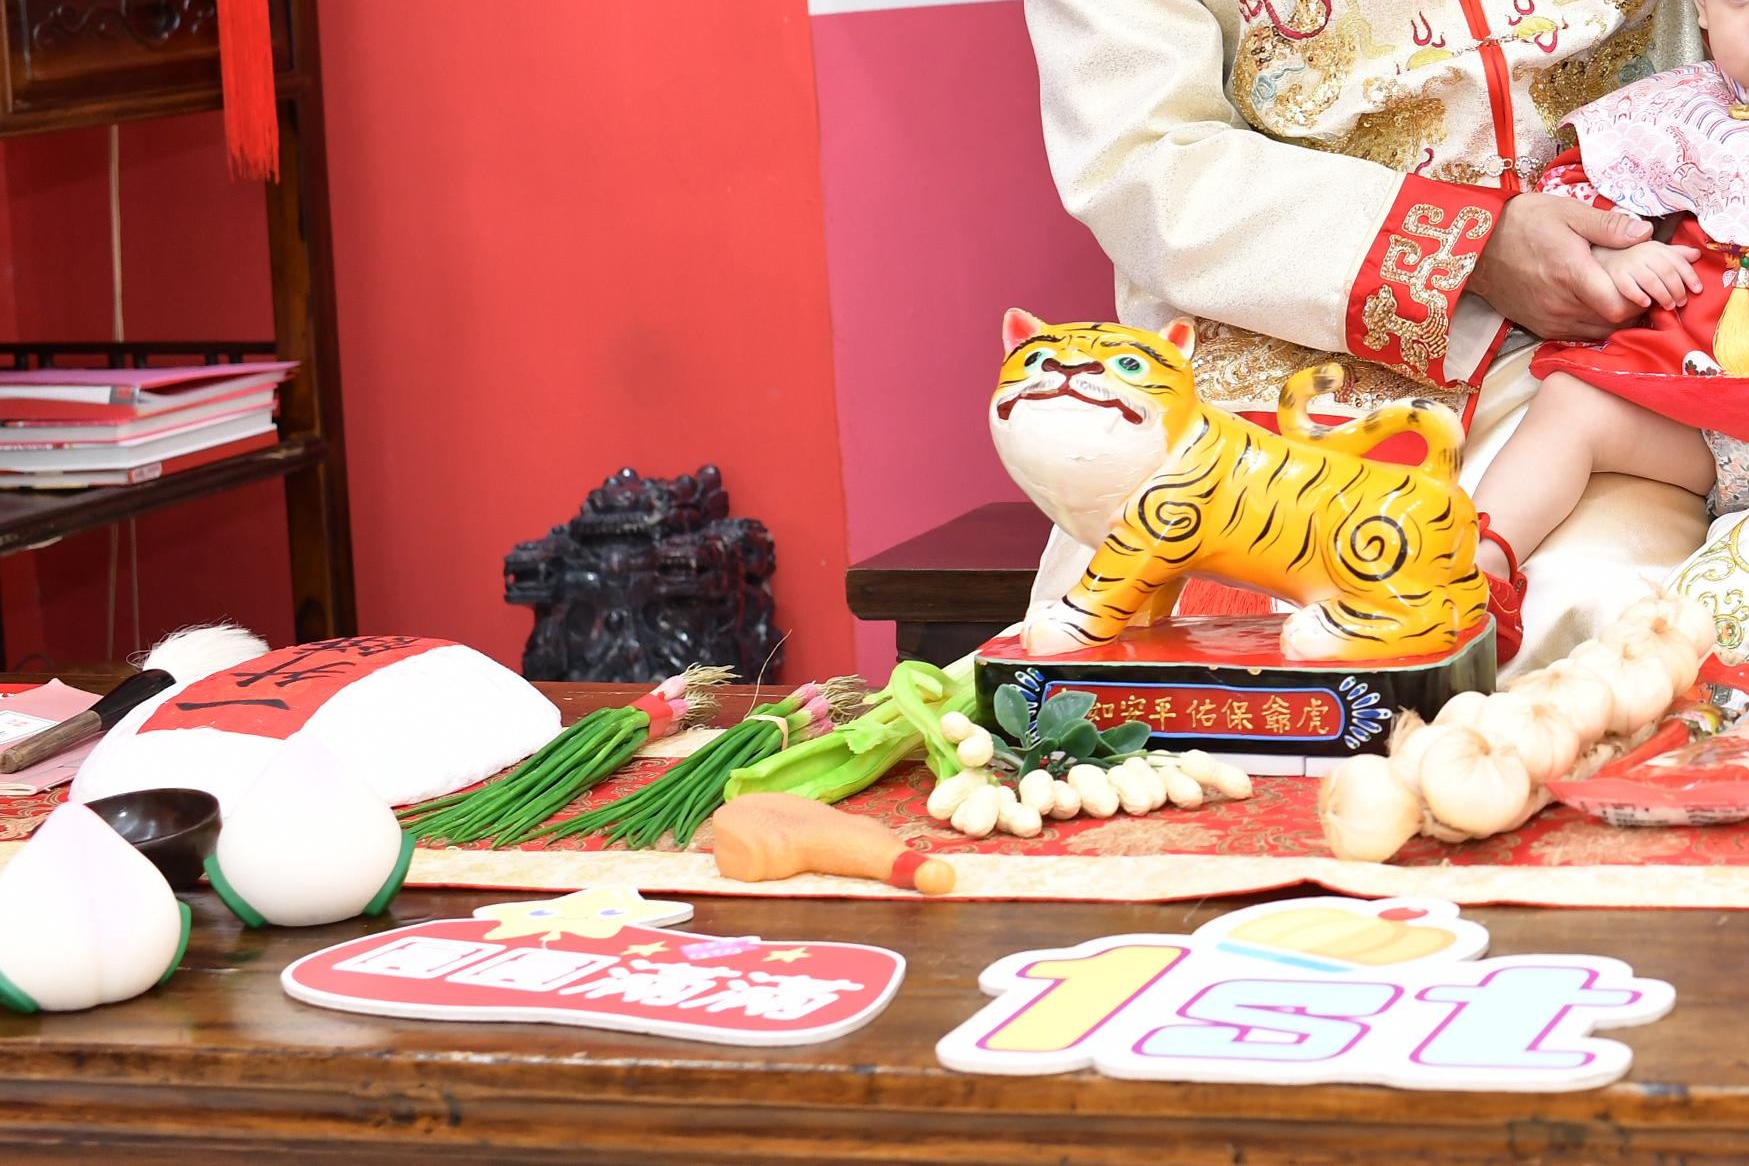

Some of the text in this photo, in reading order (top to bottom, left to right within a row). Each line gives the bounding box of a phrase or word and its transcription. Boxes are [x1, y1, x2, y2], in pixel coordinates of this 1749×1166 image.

[1060, 688, 1329, 735] 虎爺保佑平安如
[975, 944, 1642, 1069] 1st
